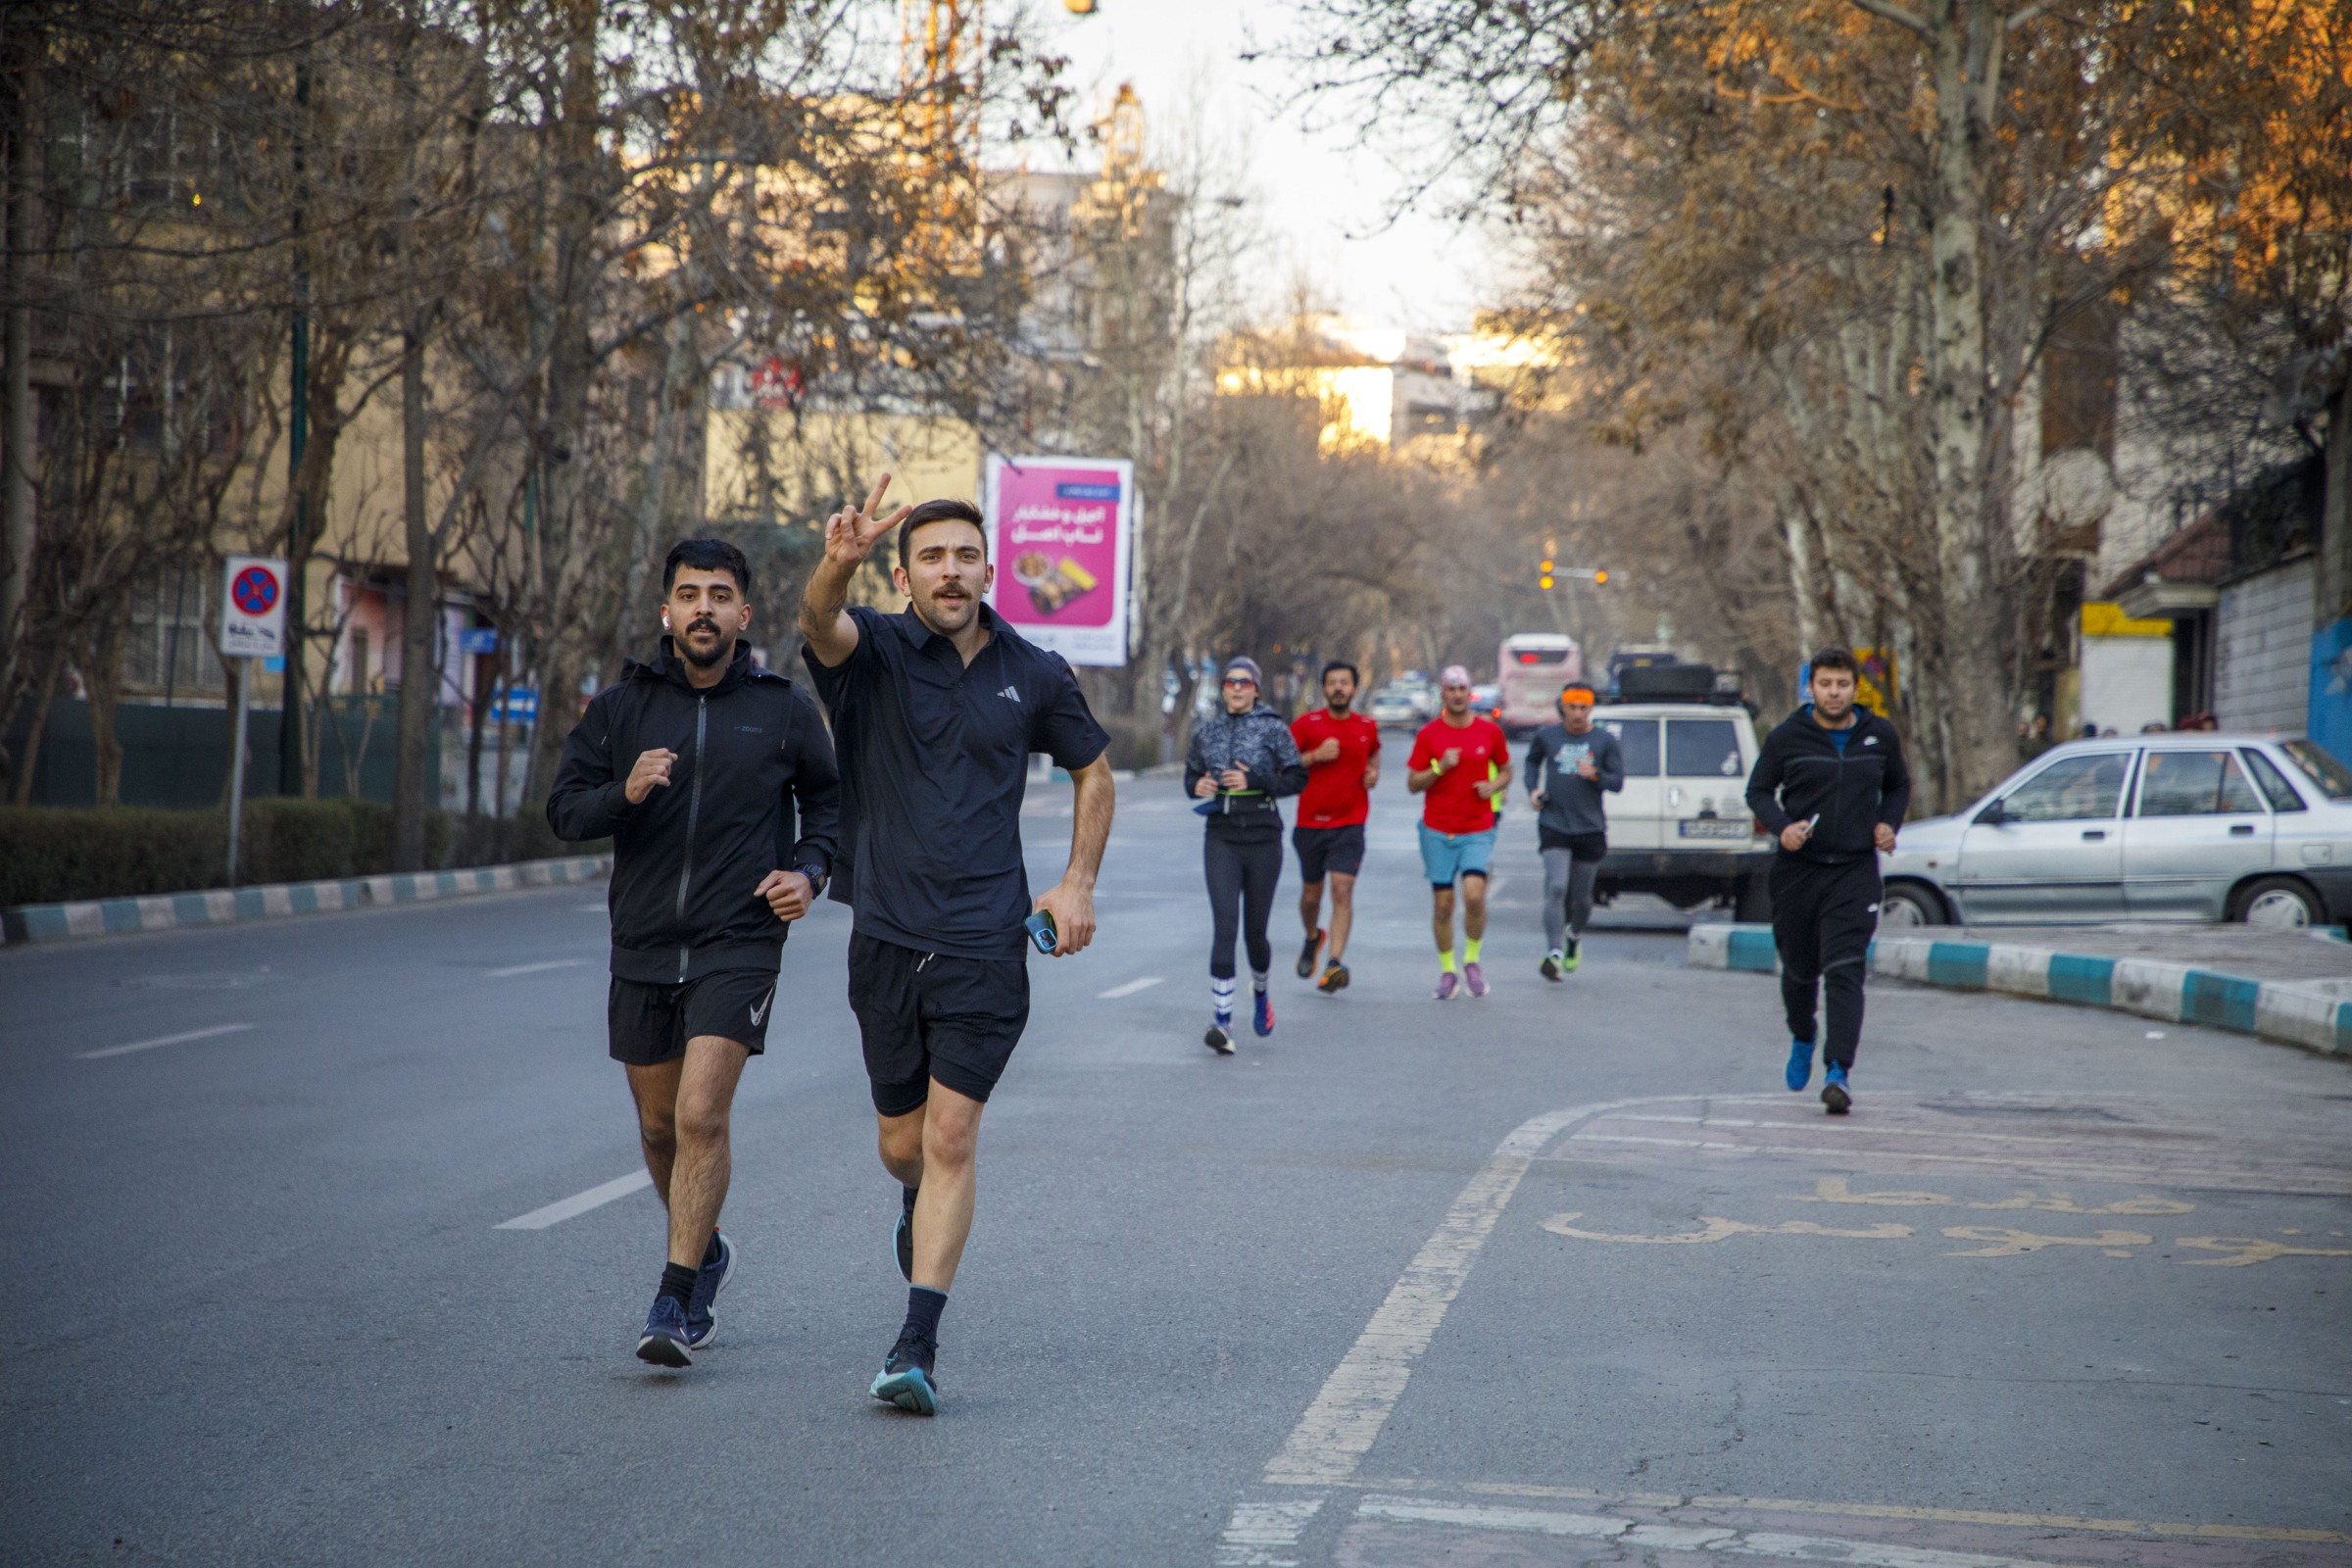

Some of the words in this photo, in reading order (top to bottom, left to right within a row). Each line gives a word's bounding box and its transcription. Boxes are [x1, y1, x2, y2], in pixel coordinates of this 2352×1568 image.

[1060, 508, 1072, 525] و
[1776, 1175, 2196, 1216] فقط
[1539, 1211, 2352, 1267] توبوس
